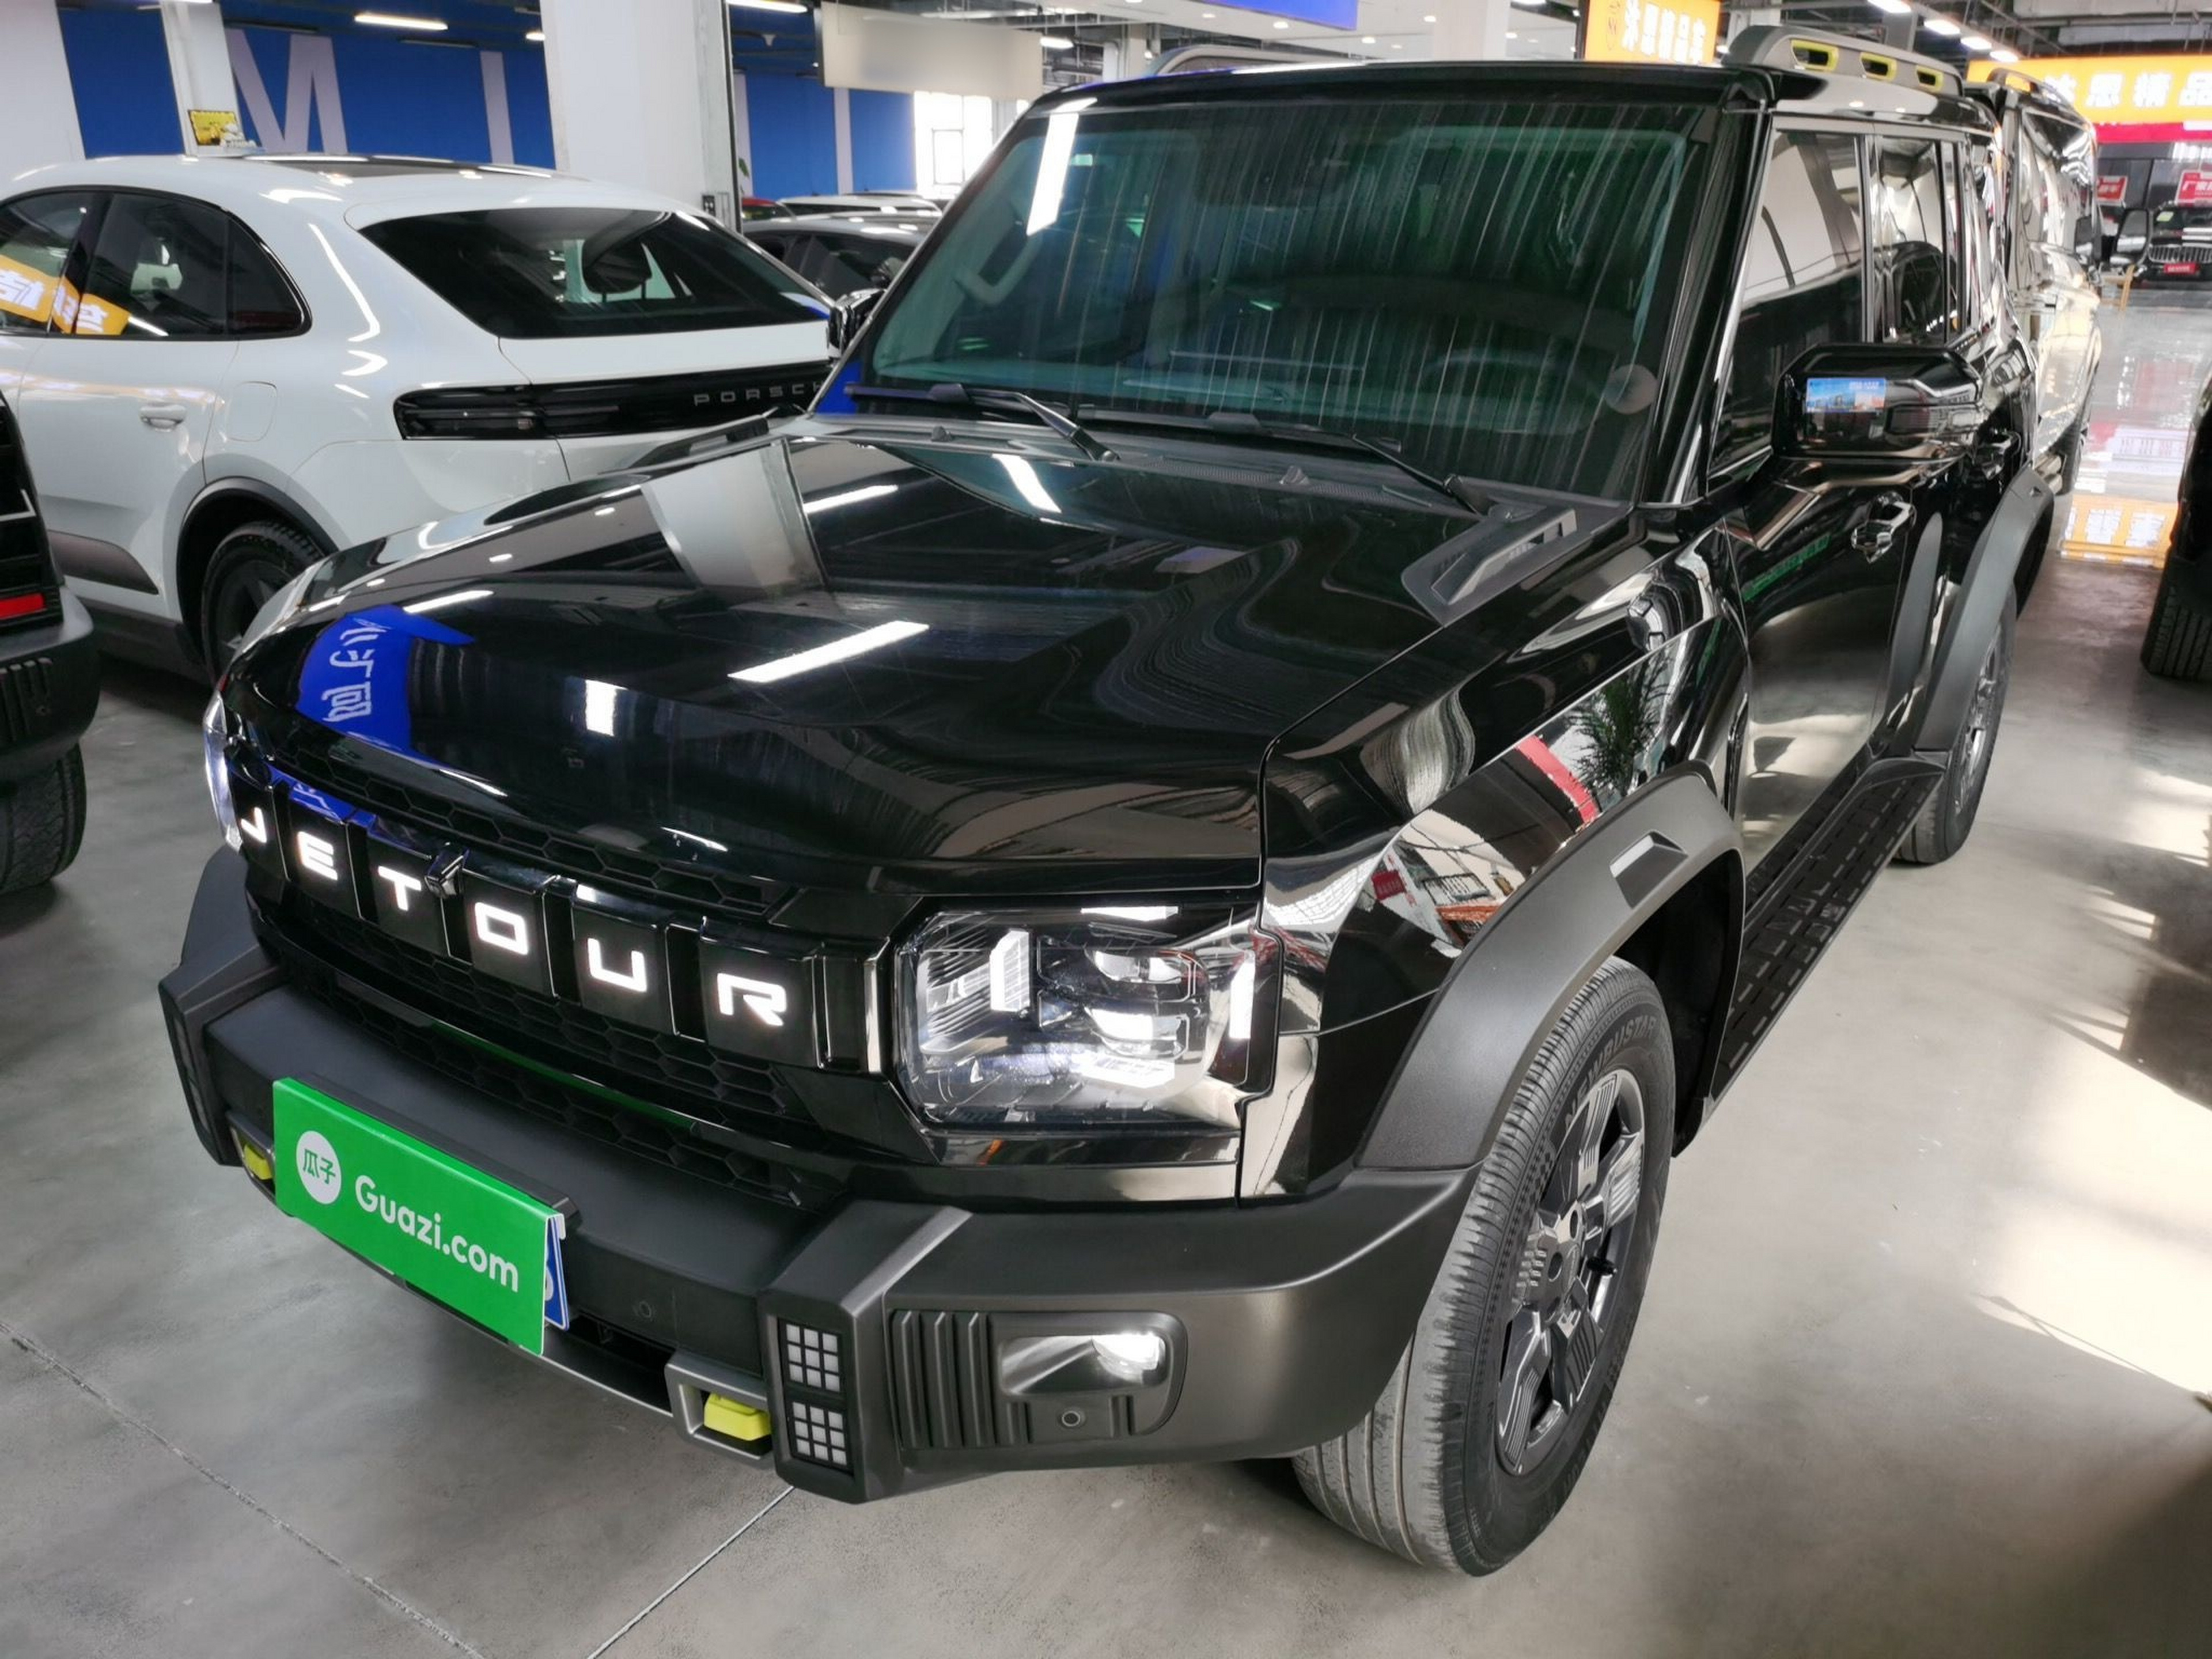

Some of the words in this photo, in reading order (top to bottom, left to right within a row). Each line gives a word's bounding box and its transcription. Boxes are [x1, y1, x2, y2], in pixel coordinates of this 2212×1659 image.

[240, 808, 787, 1027] JETOUR
[302, 1149, 336, 1185] 瓜子
[355, 1175, 518, 1292] Guazi.com
